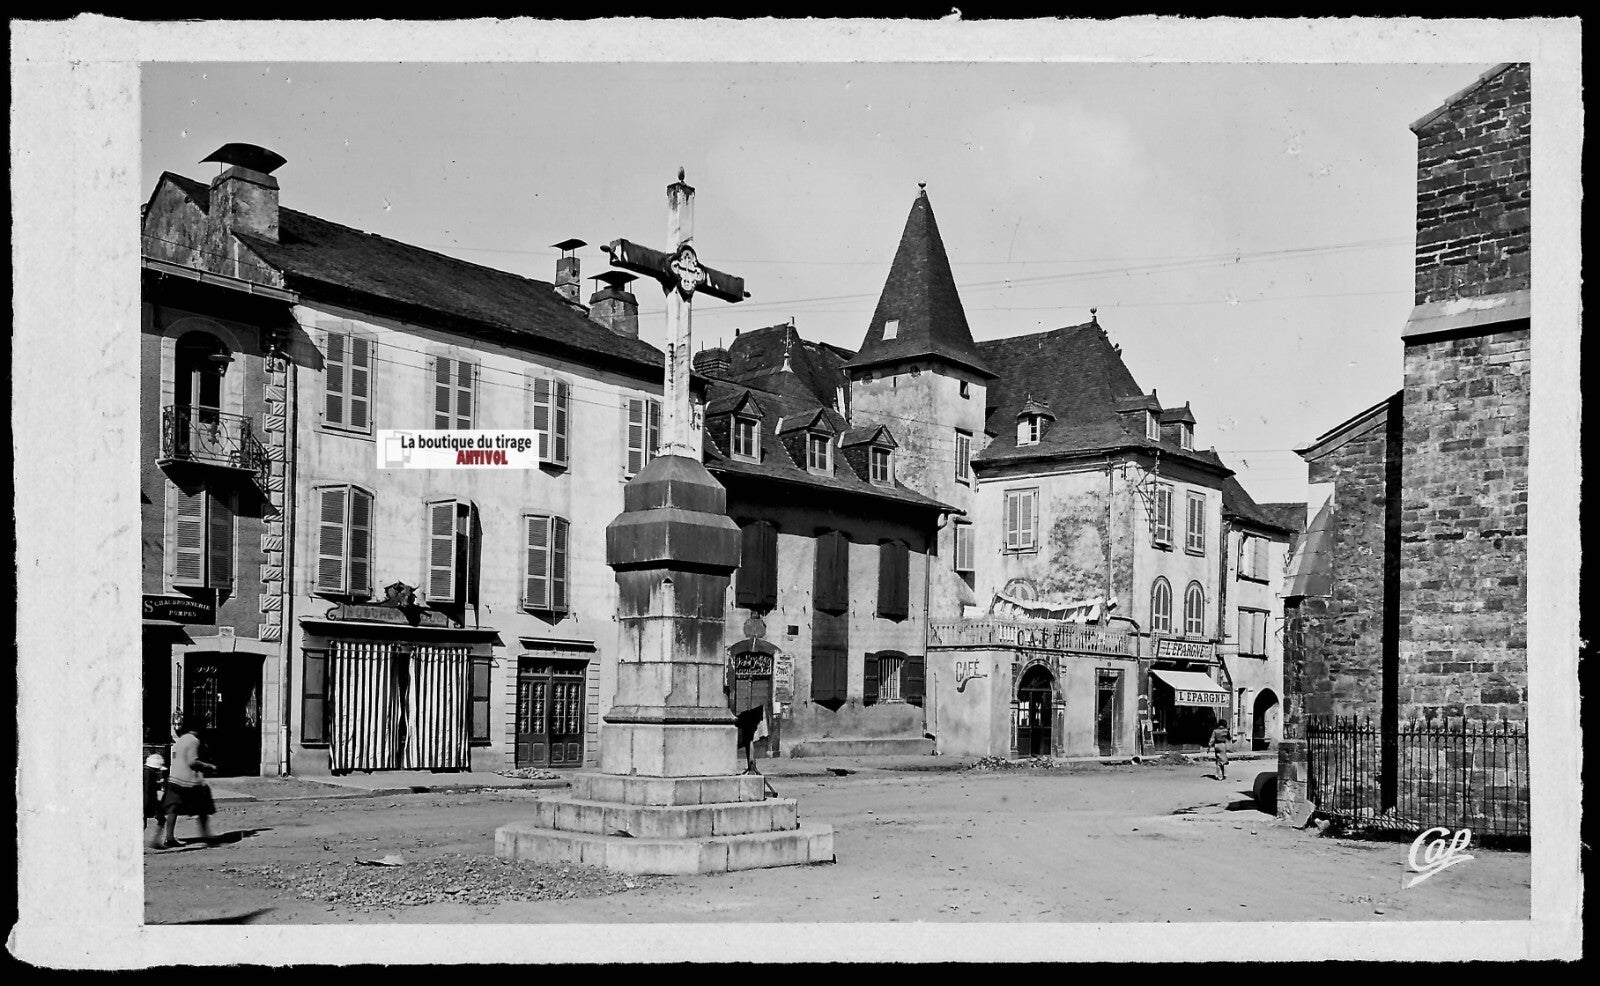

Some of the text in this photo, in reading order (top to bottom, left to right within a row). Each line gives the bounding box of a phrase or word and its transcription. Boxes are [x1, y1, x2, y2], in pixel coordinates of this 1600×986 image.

[1166, 642, 1206, 658] L'EPARGNE
[955, 659, 980, 683] CAFÉ
[1178, 691, 1226, 703] L'EPARGNE
